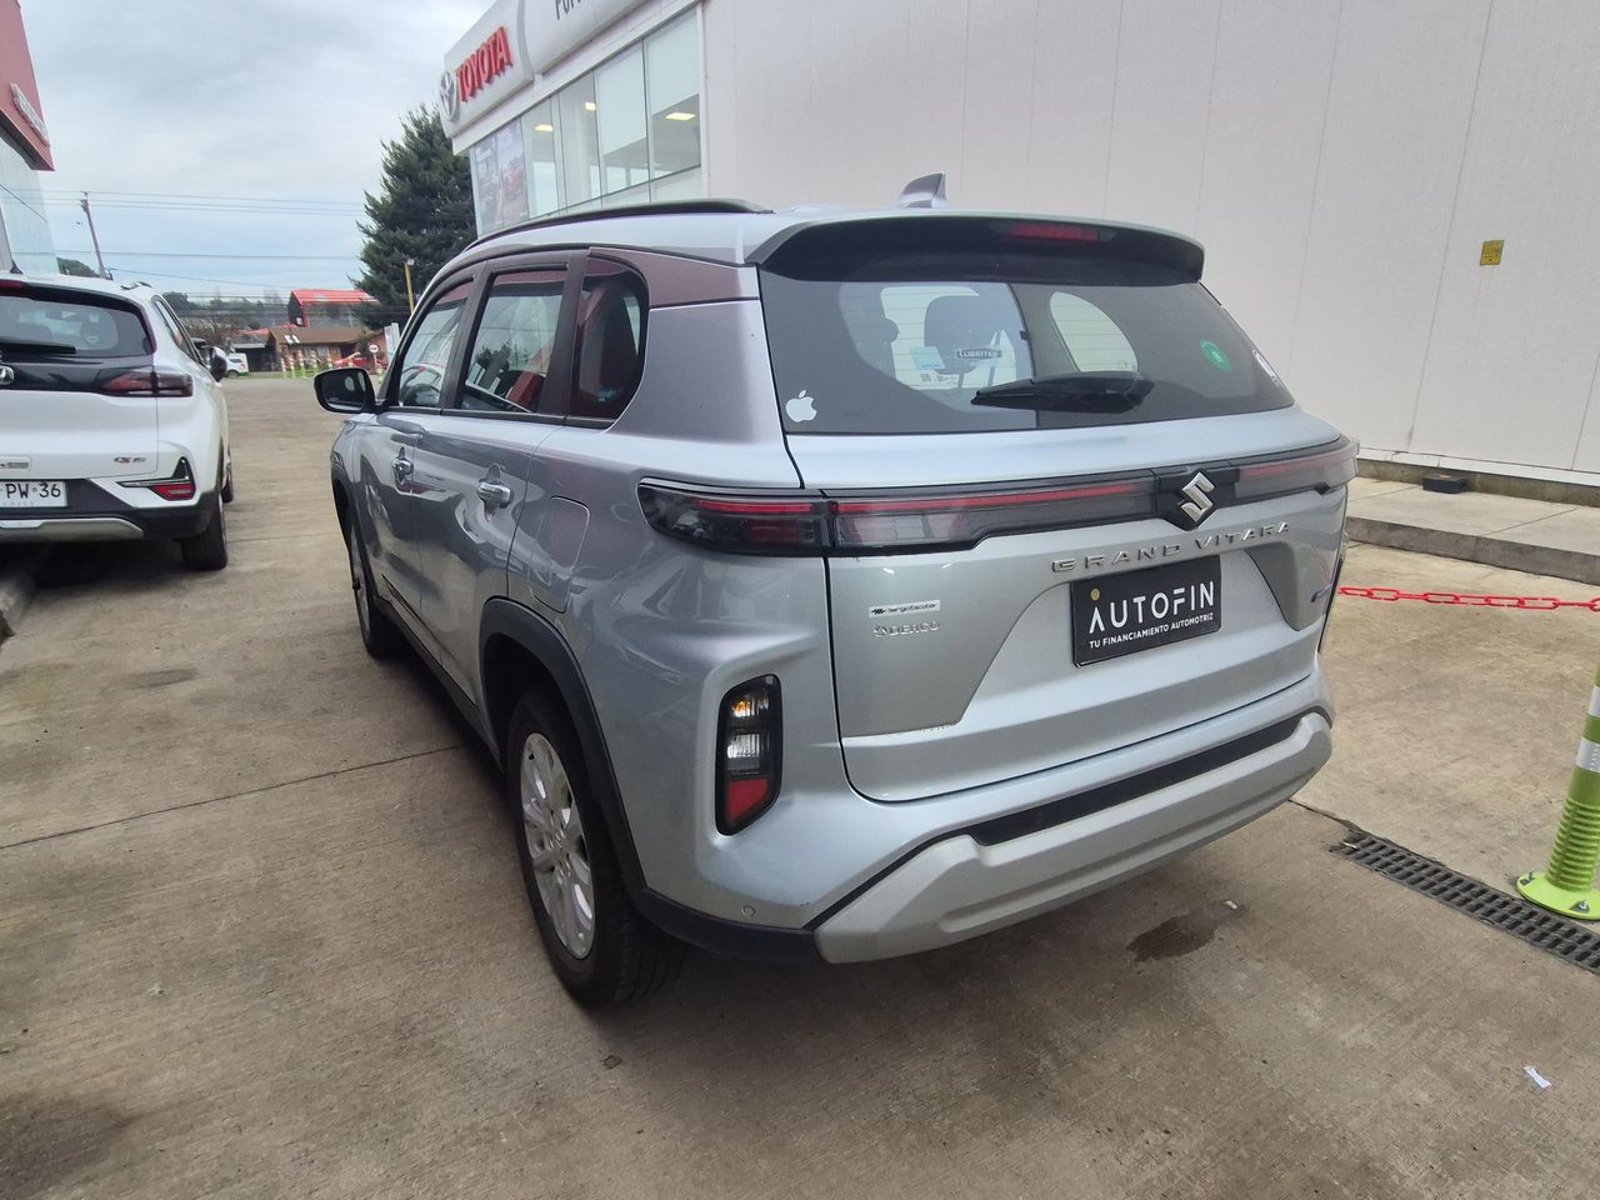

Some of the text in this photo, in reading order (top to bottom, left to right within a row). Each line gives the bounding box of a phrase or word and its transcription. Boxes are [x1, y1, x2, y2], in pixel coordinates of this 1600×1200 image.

[455, 26, 513, 103] TOYOTA
[1052, 521, 1289, 573] GRAND VITARA
[1089, 581, 1214, 634] AUTOFIN
[1089, 612, 1214, 649] TU FINANCIAMIENTO AUTOMOTRIZ
